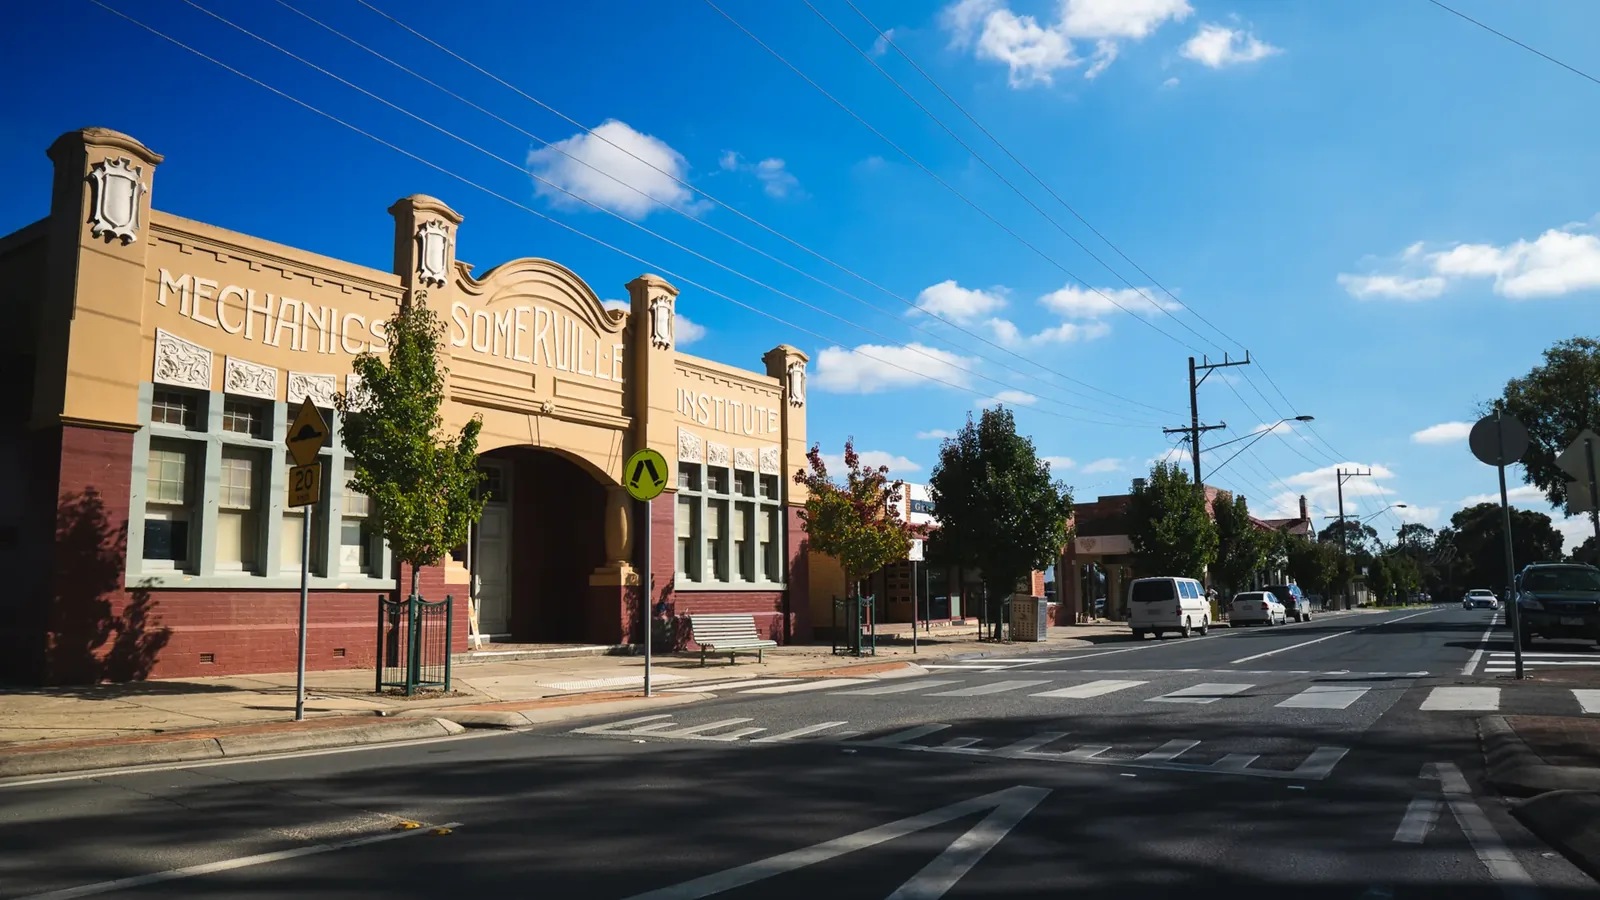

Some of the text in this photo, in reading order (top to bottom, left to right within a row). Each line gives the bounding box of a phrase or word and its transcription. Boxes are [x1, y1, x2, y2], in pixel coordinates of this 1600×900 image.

[156, 268, 389, 355] MECHANICS
[676, 387, 779, 436] INSTITUTE
[295, 469, 313, 492] 20
